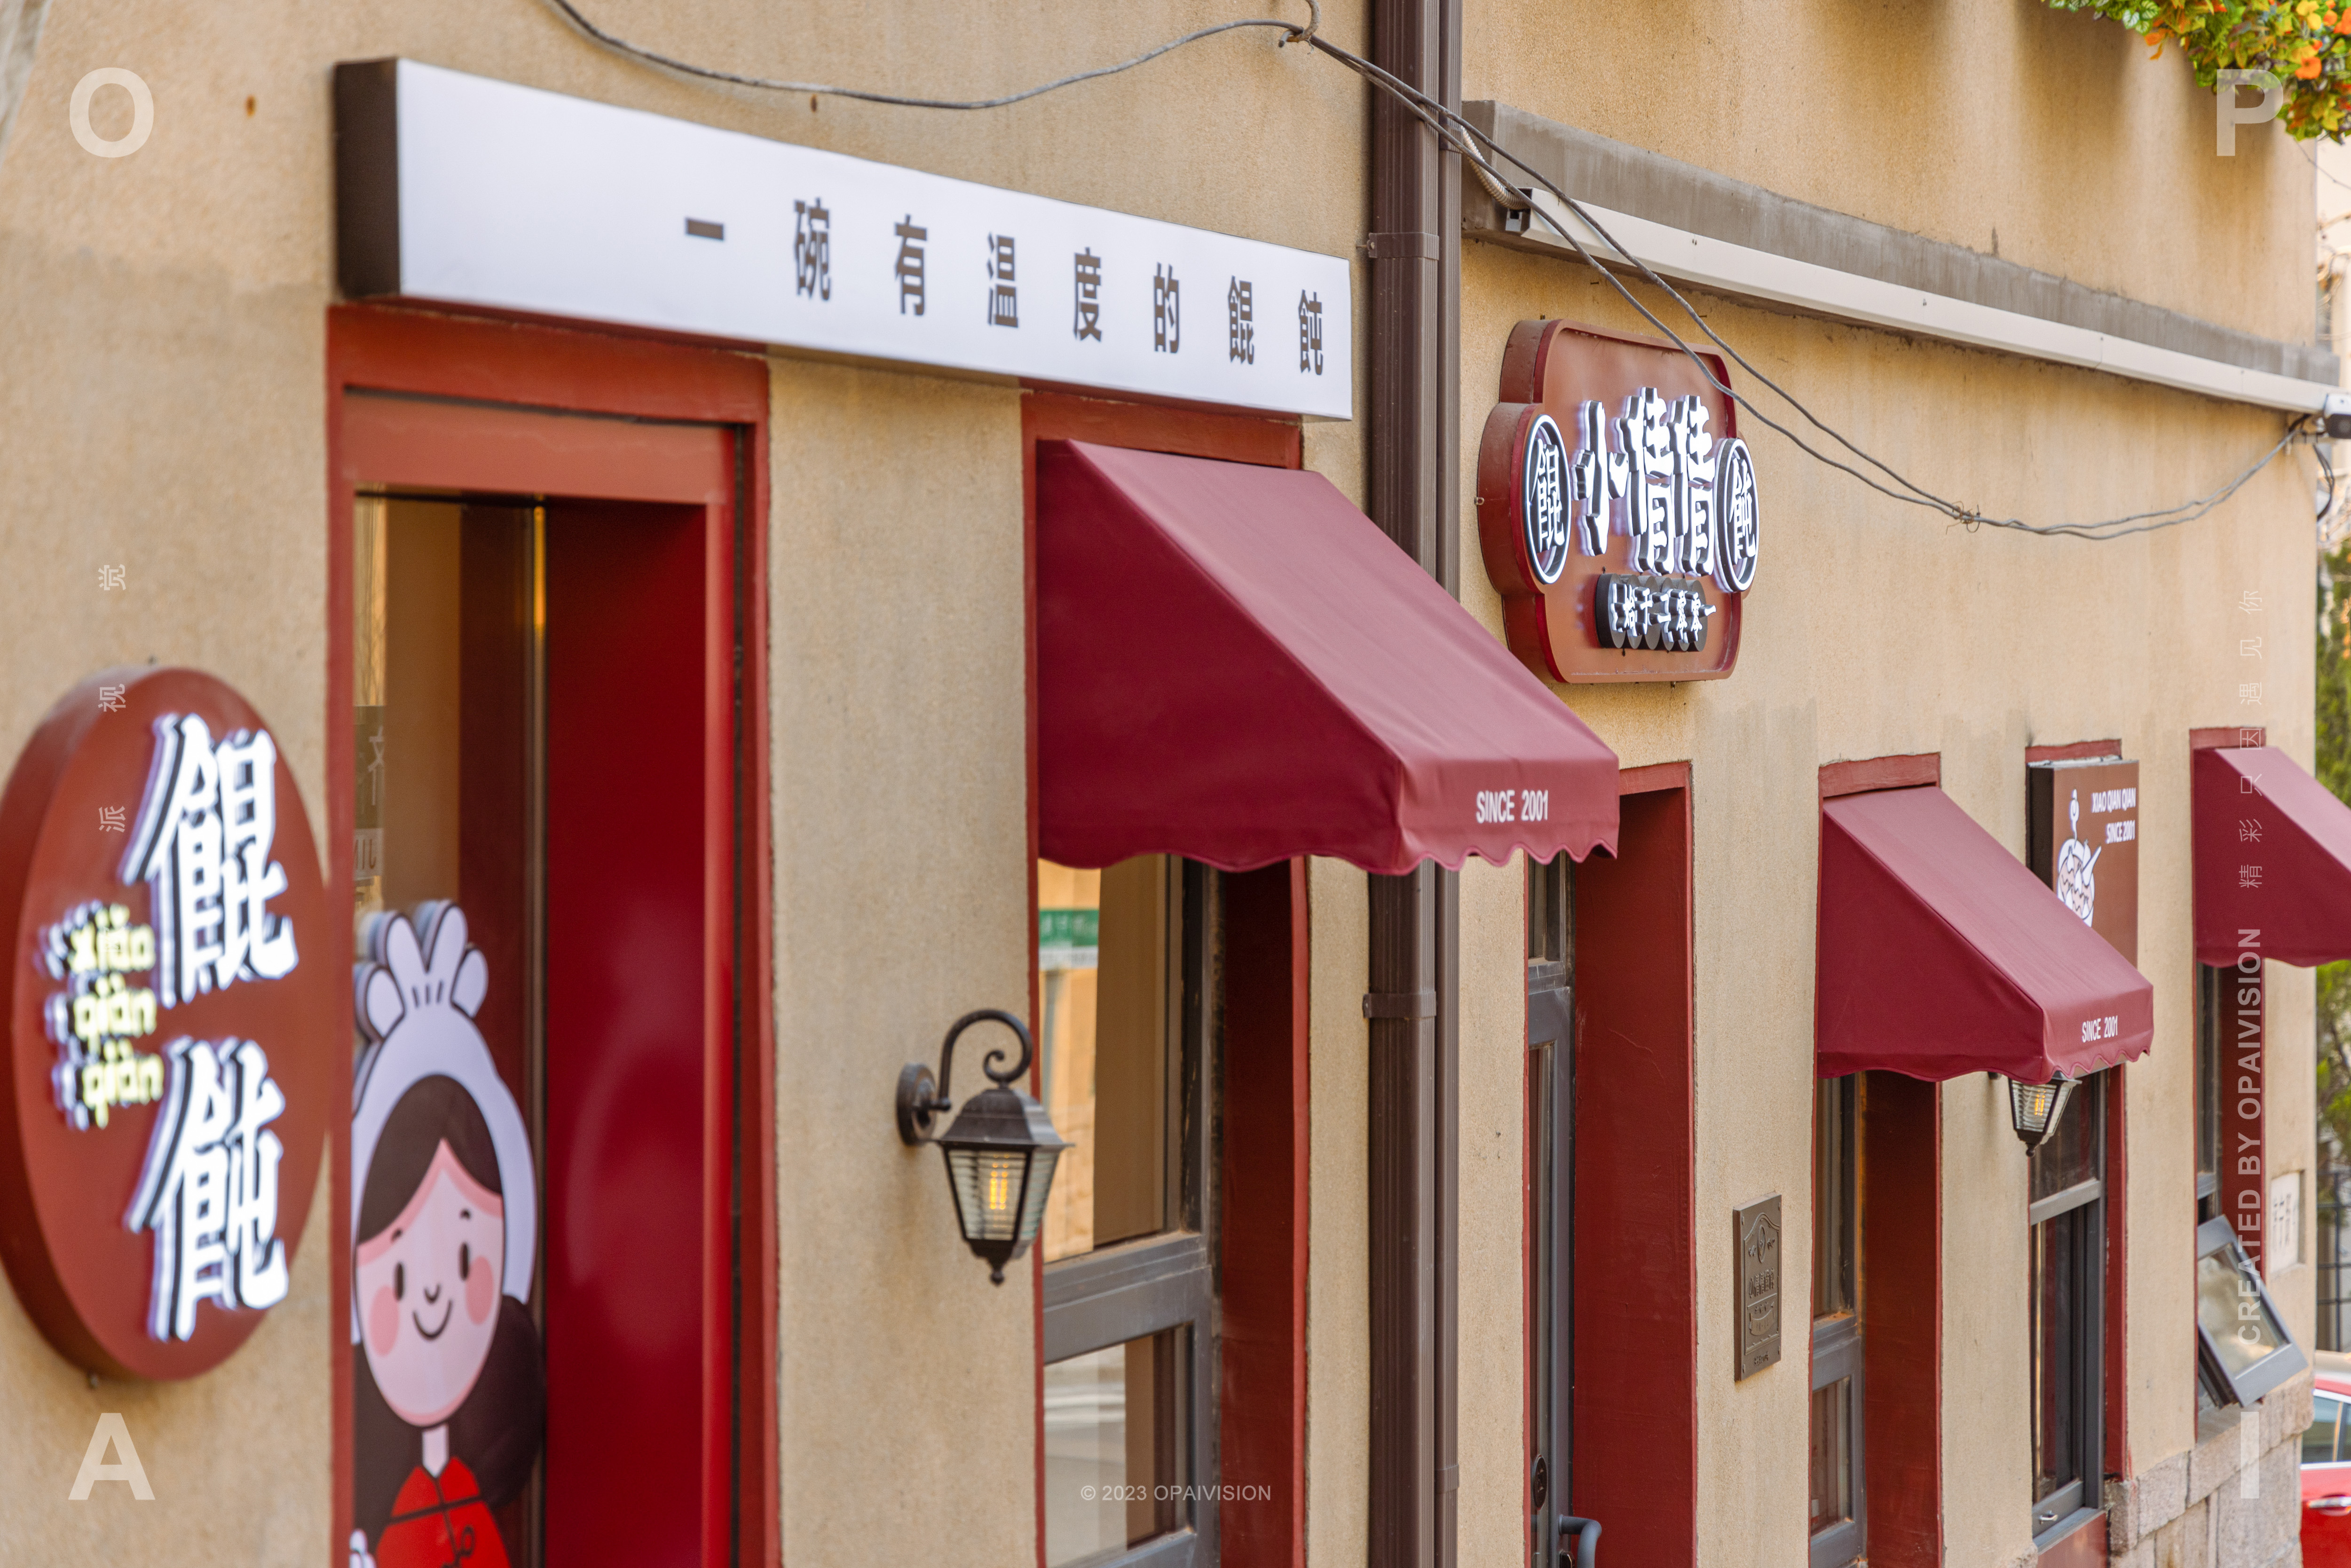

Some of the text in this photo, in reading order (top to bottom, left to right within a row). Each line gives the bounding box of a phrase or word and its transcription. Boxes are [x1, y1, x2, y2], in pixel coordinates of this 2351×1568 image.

[1475, 789, 1548, 823] SINCE 2001
[2092, 788, 2136, 813] XIAO QIAN QIAN
[2106, 820, 2135, 843] SINCE 2001
[2082, 1015, 2118, 1043] SINCE 2001
